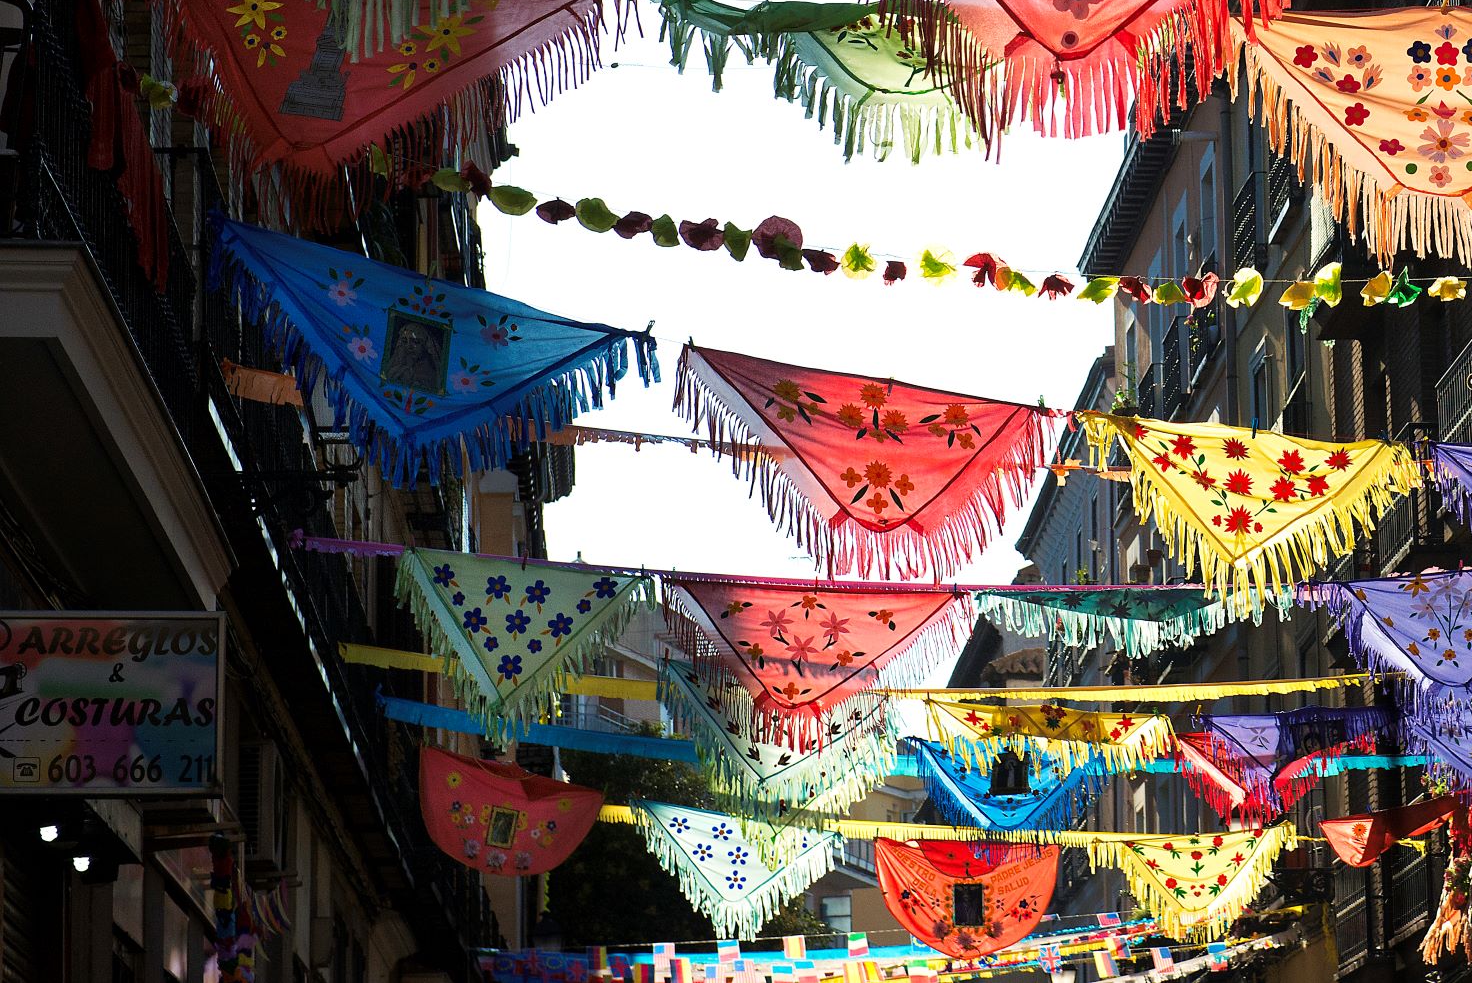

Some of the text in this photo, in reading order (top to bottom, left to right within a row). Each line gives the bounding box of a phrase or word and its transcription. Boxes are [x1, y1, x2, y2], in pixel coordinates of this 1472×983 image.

[17, 626, 217, 662] ARREGLOS
[108, 663, 125, 683] &
[14, 697, 215, 726] COSTURAS
[48, 754, 213, 782] 603 666 211
[990, 865, 1021, 884] PADRE
[998, 876, 1029, 895] SALUD
